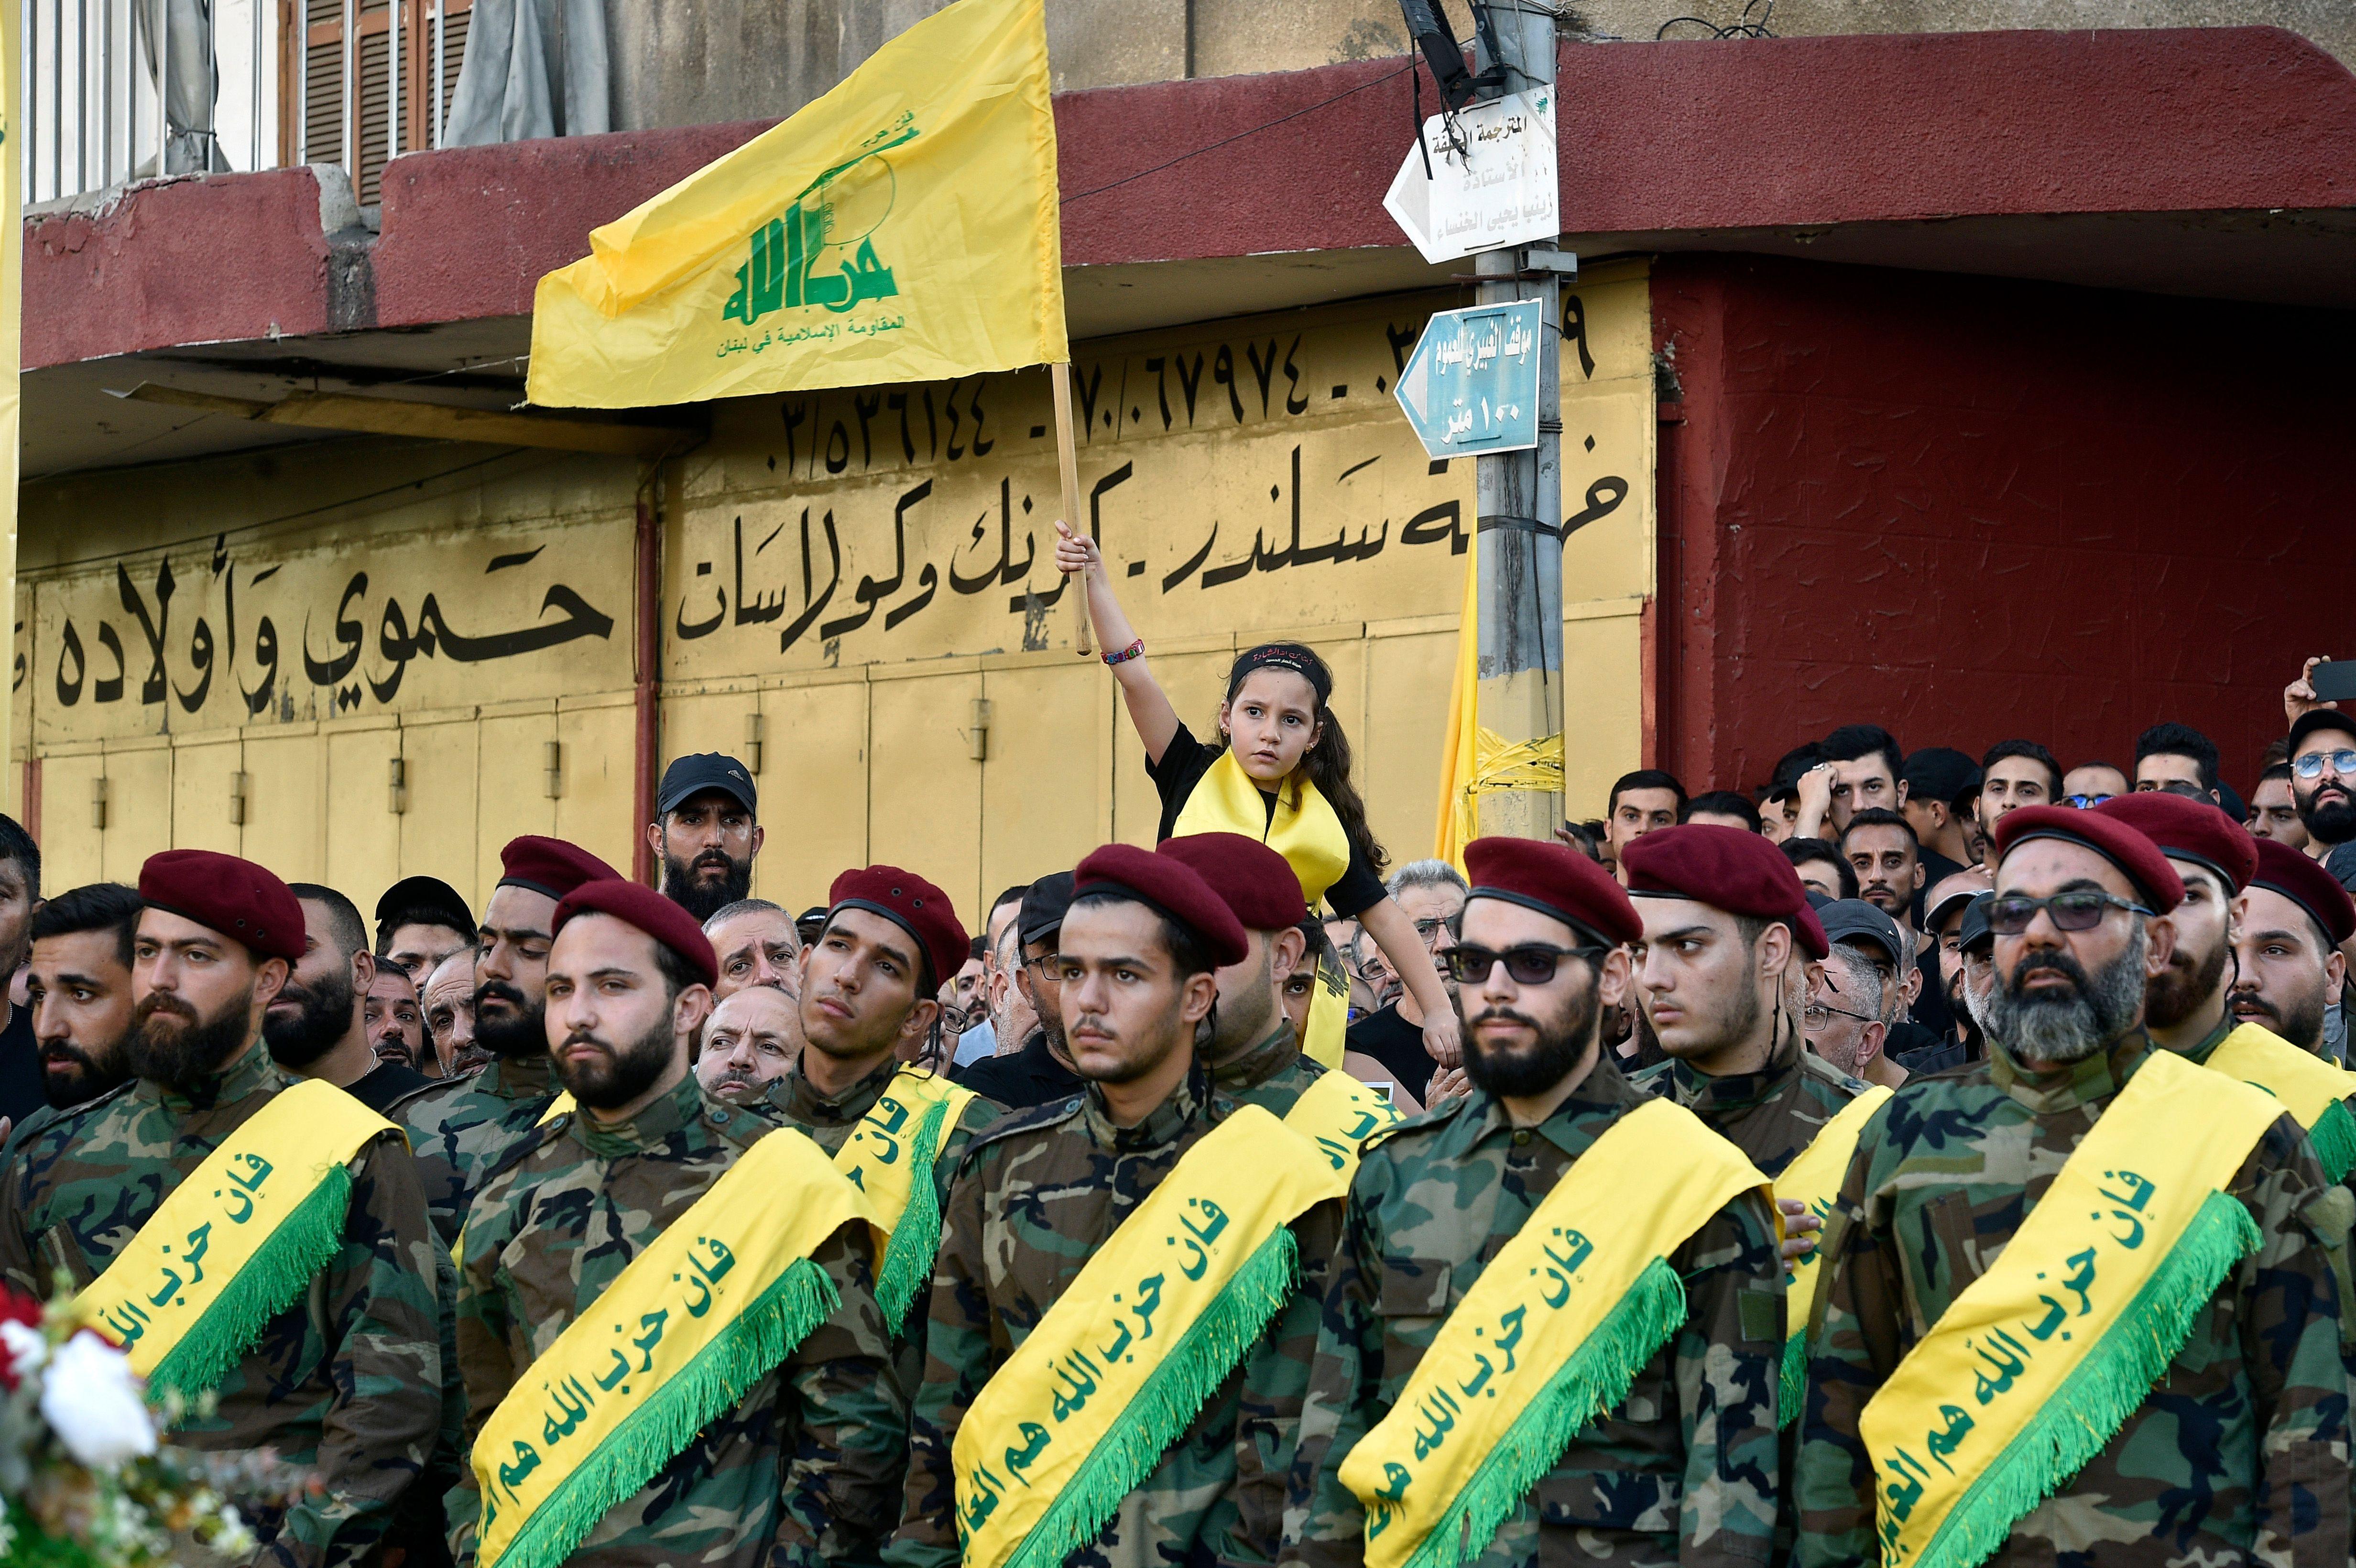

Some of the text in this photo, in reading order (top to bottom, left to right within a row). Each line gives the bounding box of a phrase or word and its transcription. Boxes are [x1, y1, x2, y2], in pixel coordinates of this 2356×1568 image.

[1477, 115, 1527, 143] المترجمة
[1523, 192, 1553, 223] زينب
[716, 315, 905, 358] المقاومة الإسلامية في لبنان
[1435, 326, 1465, 376] للعموم
[1465, 319, 1502, 378] الغبيري
[1505, 314, 1532, 366] موقف
[1441, 395, 1520, 445] ١٠٠ متر
[214, 1153, 273, 1225] فإن
[2092, 1169, 2157, 1249] فإن
[146, 1221, 212, 1308] حزب
[1167, 1197, 1230, 1281] فإن
[1529, 1226, 1594, 1309] فإن
[1096, 1271, 1165, 1364] حزب
[2021, 1245, 2098, 1343] حزب
[499, 1235, 736, 1506] فإن حزب الله هم
[1047, 1349, 1104, 1423] الله
[1458, 1303, 1527, 1398] حزب
[1965, 1326, 2032, 1405] الله
[1004, 1422, 1052, 1489] هم
[1414, 1384, 1462, 1462] الله
[1927, 1405, 1975, 1476] هم
